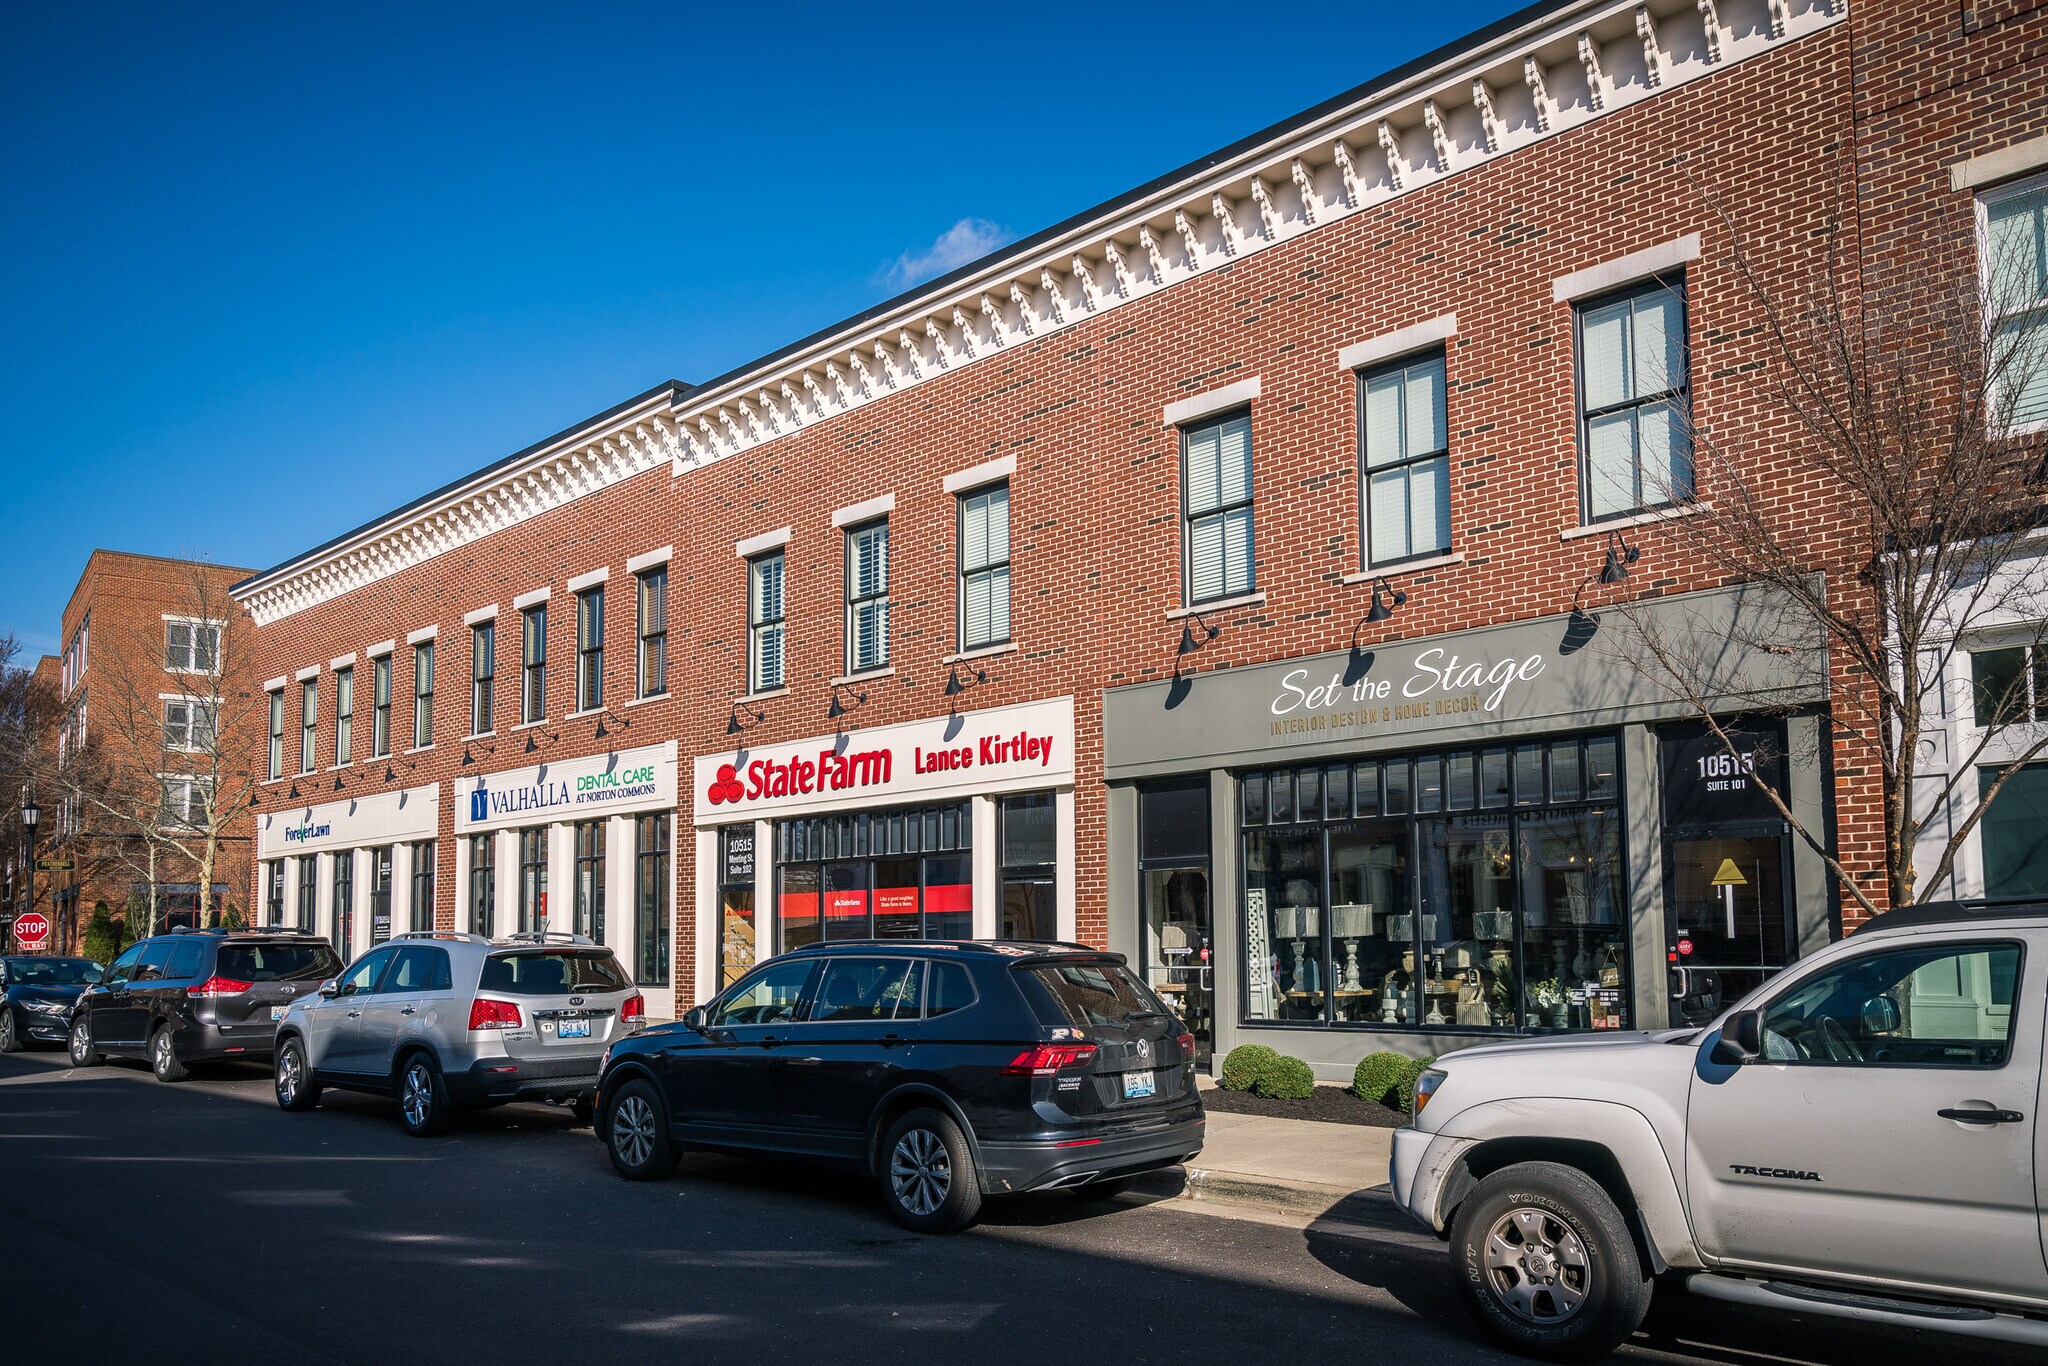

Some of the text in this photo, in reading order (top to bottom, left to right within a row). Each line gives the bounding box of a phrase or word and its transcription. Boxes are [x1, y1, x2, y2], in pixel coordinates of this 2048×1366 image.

[1270, 647, 1547, 716] Set the Stage
[1270, 695, 1480, 736] INTERIOR DESIGN & HOME DECOR
[915, 731, 1054, 775] Lance Kirtley
[1697, 752, 1753, 778] 10515
[577, 766, 655, 791] DENTAL CARE
[1707, 779, 1746, 791] SUITE 101
[491, 781, 570, 814] VALHALLA
[576, 784, 656, 804] AT NORTON COMMONS
[730, 838, 752, 852] 10515
[729, 854, 747, 864] Meeting
[729, 865, 742, 874] Suite
[16, 922, 46, 934] STOP
[1729, 1164, 1825, 1182] TACOMA
[1508, 1193, 1598, 1255] YOKOHAMA
[1467, 1243, 1481, 1283] H/T
